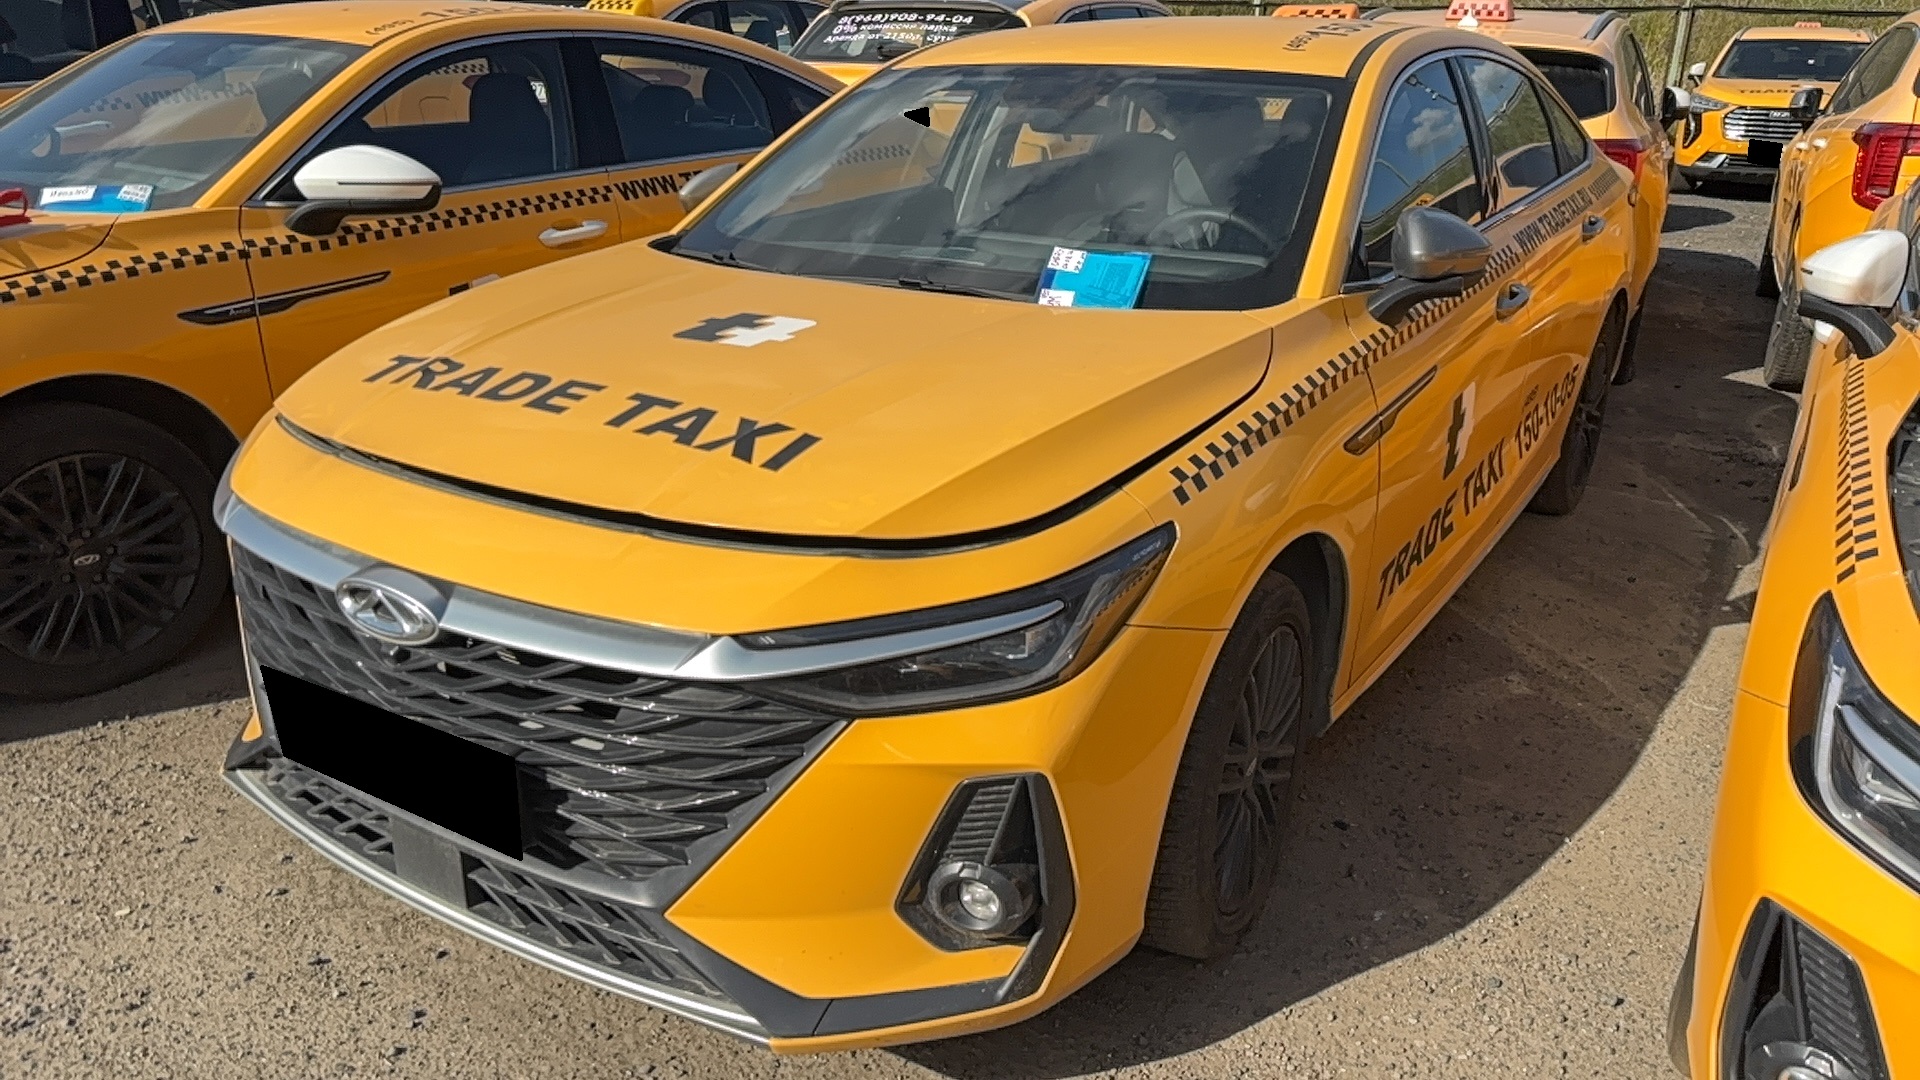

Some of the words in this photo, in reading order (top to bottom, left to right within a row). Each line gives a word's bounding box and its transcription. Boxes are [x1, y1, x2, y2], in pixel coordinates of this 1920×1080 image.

[832, 23, 858, 35] 0%
[838, 13, 975, 25] 8(968)908-94-04
[1512, 187, 1594, 257] WWW.TRADETAXI.RU
[362, 354, 608, 415] TRADE
[603, 392, 823, 472] TAXI
[1514, 363, 1580, 460] 150-10-05
[1377, 489, 1458, 611] TRADE
[1462, 437, 1506, 518] TAXI
